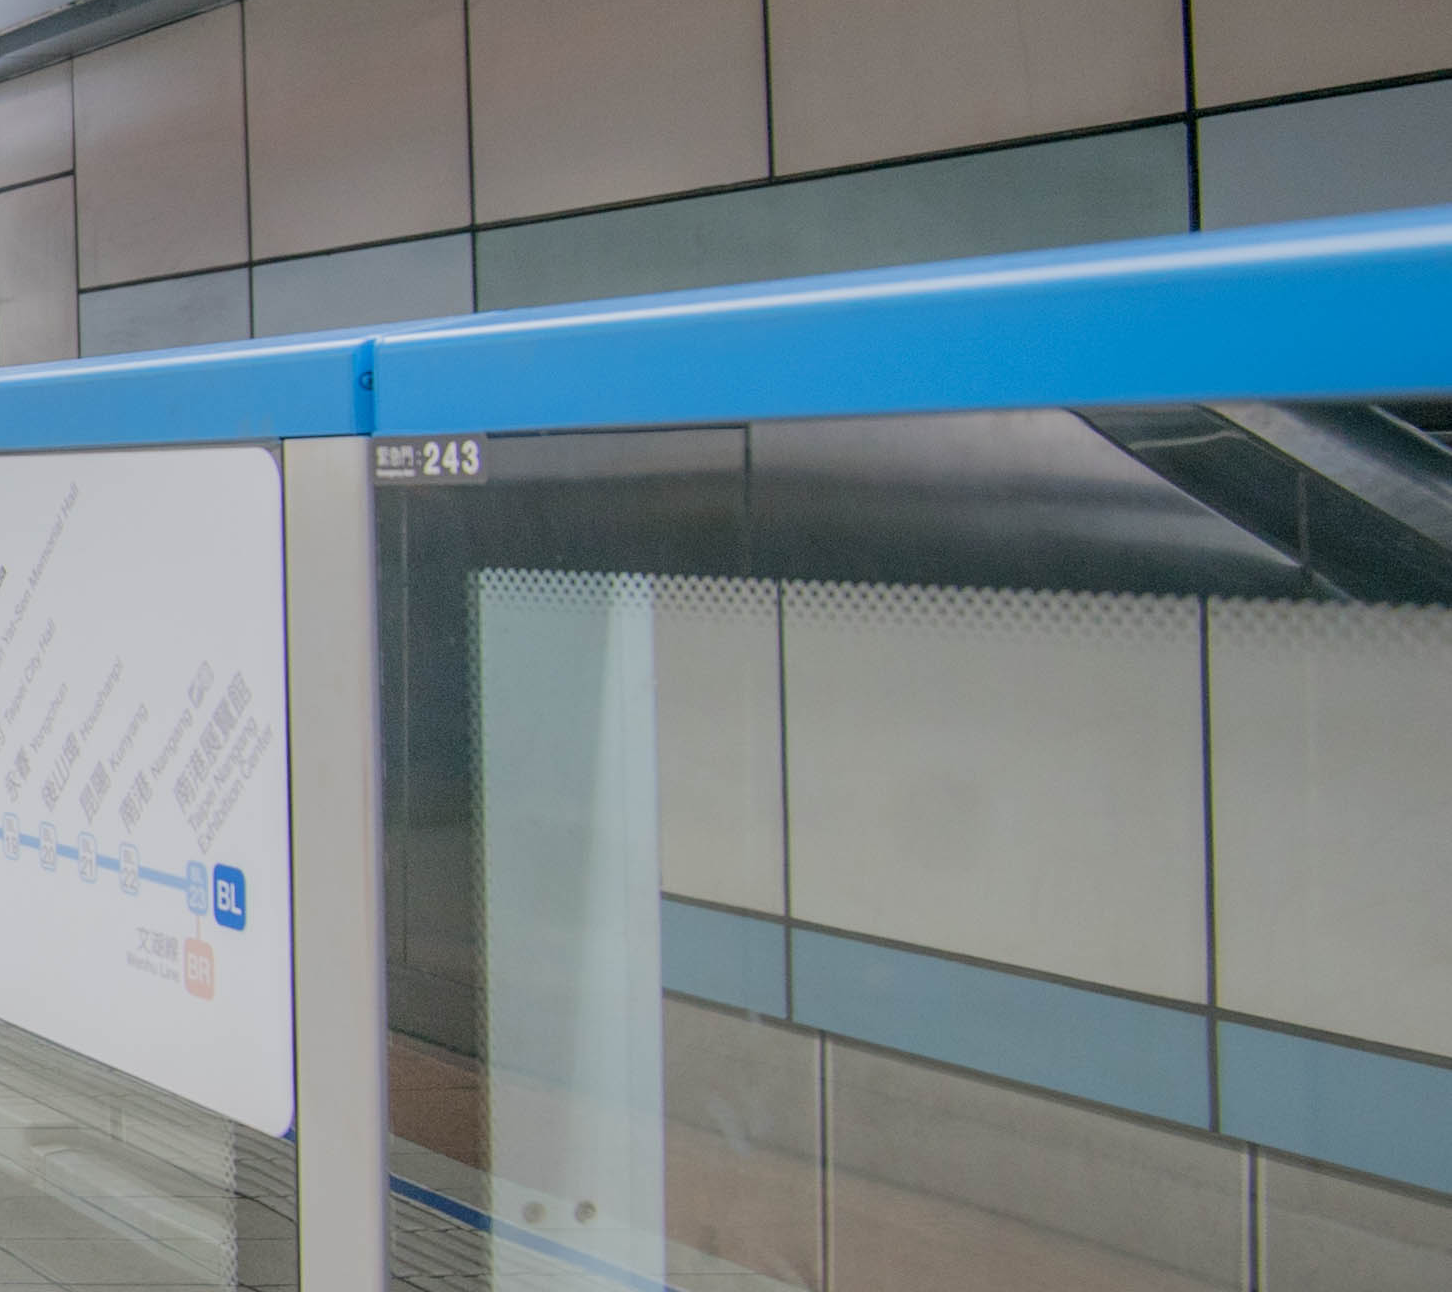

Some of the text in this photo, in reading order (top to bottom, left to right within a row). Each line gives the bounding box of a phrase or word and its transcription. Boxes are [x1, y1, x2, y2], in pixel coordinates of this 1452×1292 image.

[423, 439, 479, 476] 243
[217, 880, 242, 915] BL
[187, 955, 211, 986] BR
